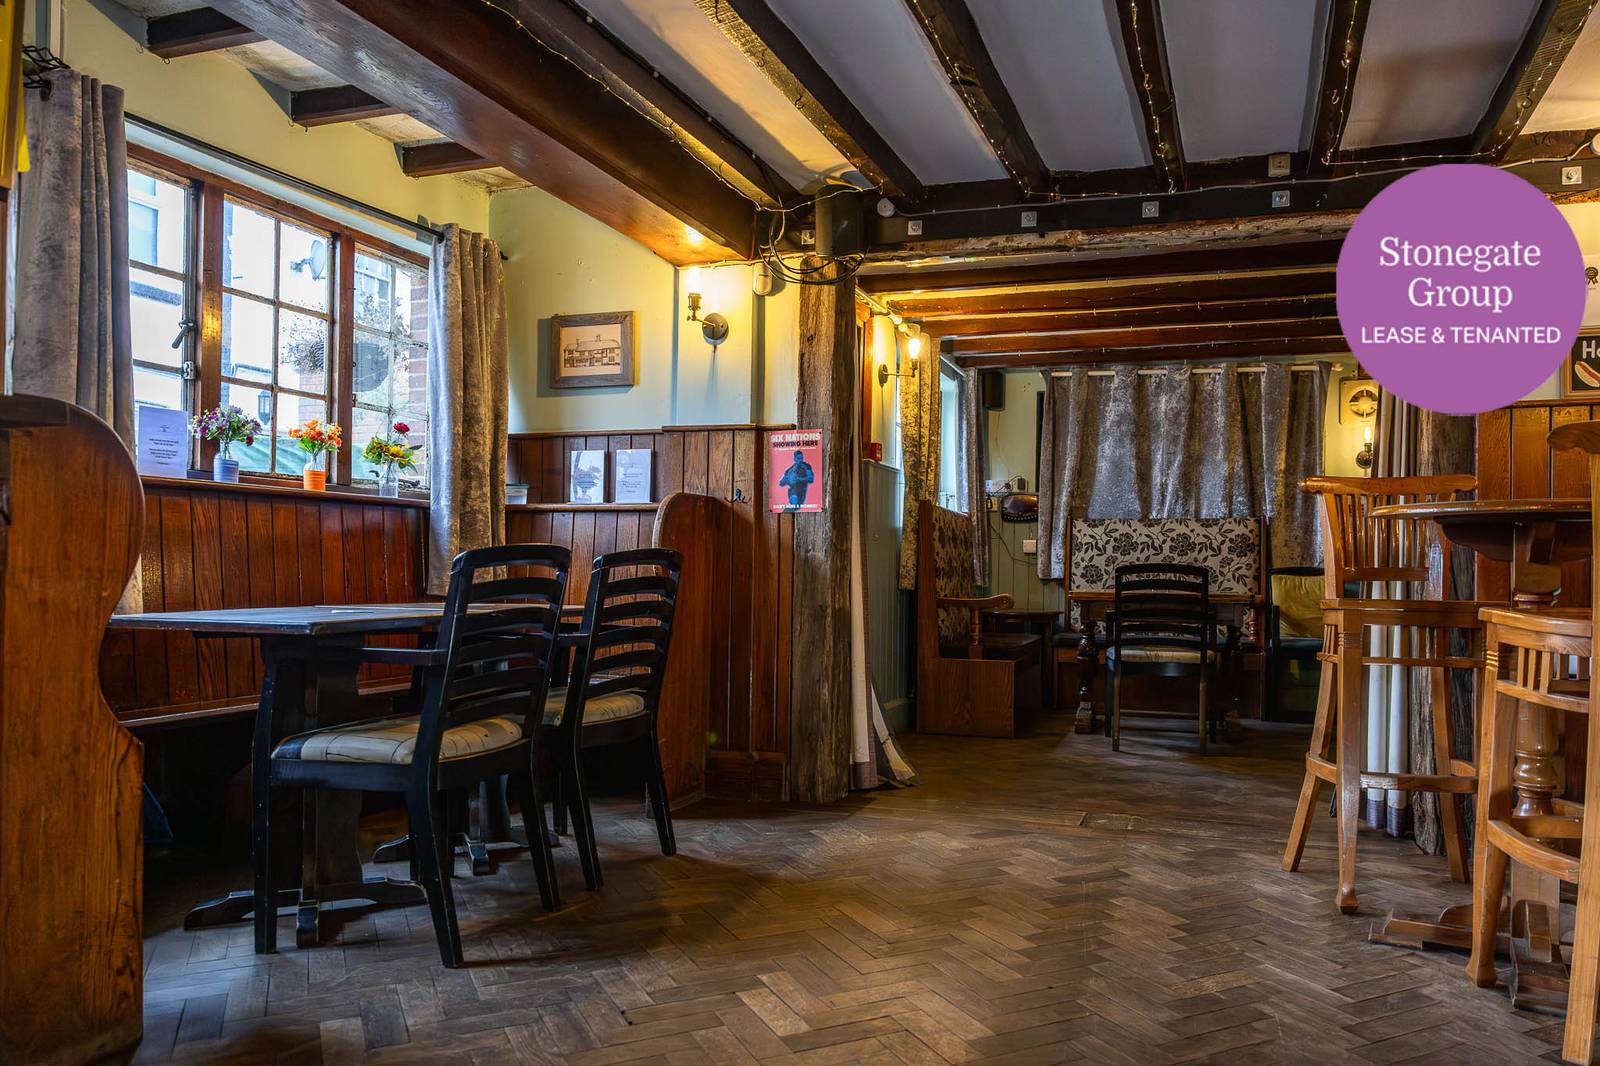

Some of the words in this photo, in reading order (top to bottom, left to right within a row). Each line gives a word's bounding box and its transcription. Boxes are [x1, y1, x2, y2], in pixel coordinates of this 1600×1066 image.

[771, 434, 784, 442] SIX
[785, 432, 820, 441] NATIONS
[773, 440, 800, 448] SHOWING
